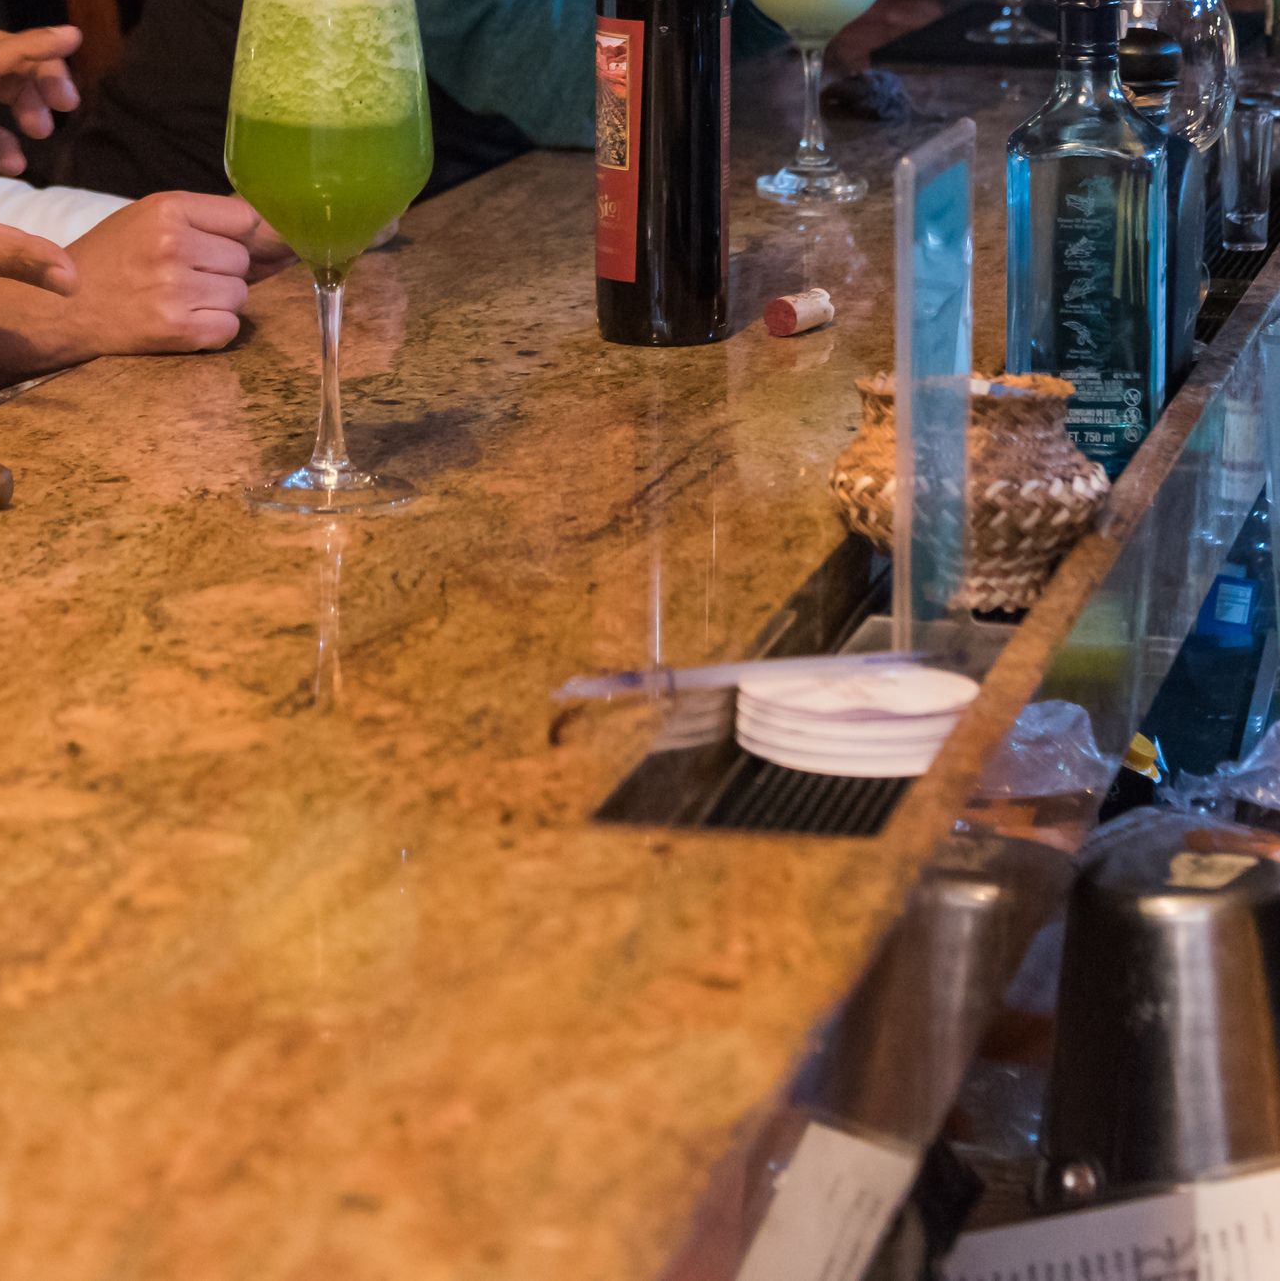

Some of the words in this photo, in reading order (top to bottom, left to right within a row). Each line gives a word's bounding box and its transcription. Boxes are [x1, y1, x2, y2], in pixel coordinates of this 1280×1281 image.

[1066, 431, 1081, 442] ET.
[1084, 431, 1101, 442] 750
[1103, 431, 1115, 442] ml
